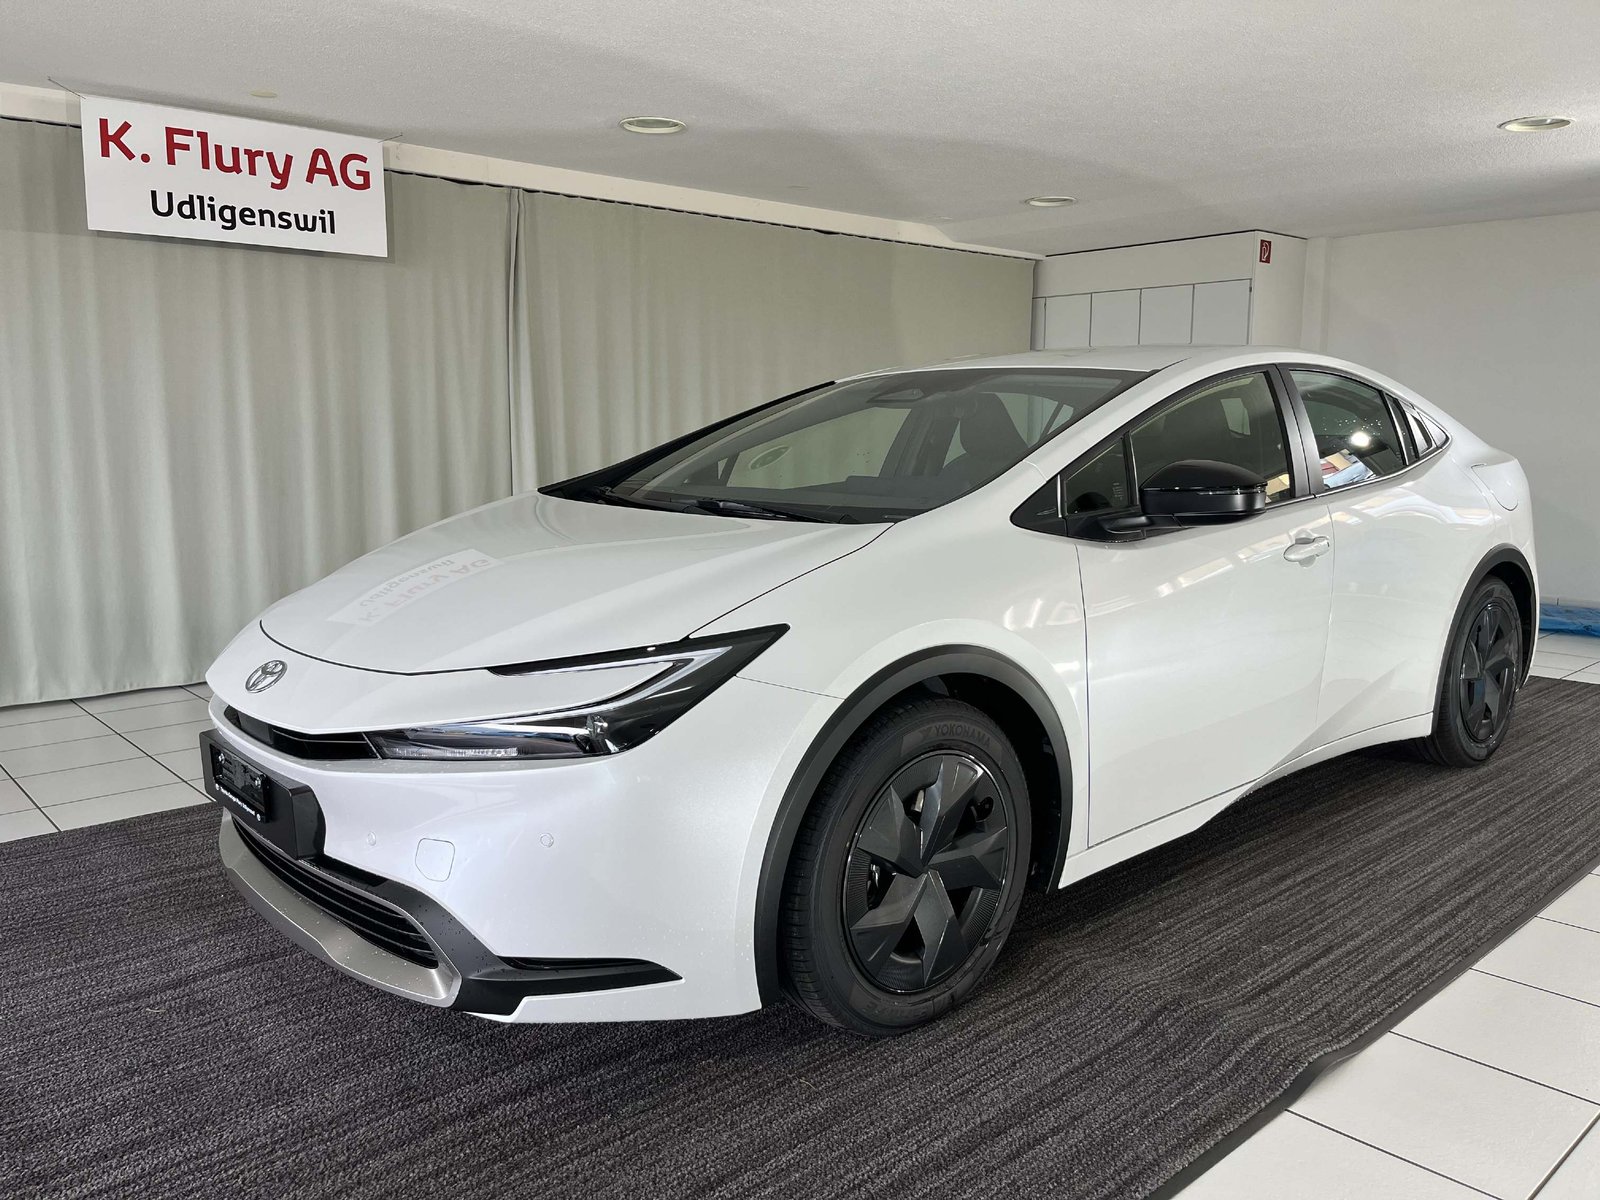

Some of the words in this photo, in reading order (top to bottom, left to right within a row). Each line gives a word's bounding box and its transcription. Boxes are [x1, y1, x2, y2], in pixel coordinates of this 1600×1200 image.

[98, 118, 151, 164] K.
[165, 126, 294, 190] Flury
[305, 147, 371, 191] AG
[150, 189, 336, 235] Udligenswil
[934, 722, 991, 749] YOKOHAMA
